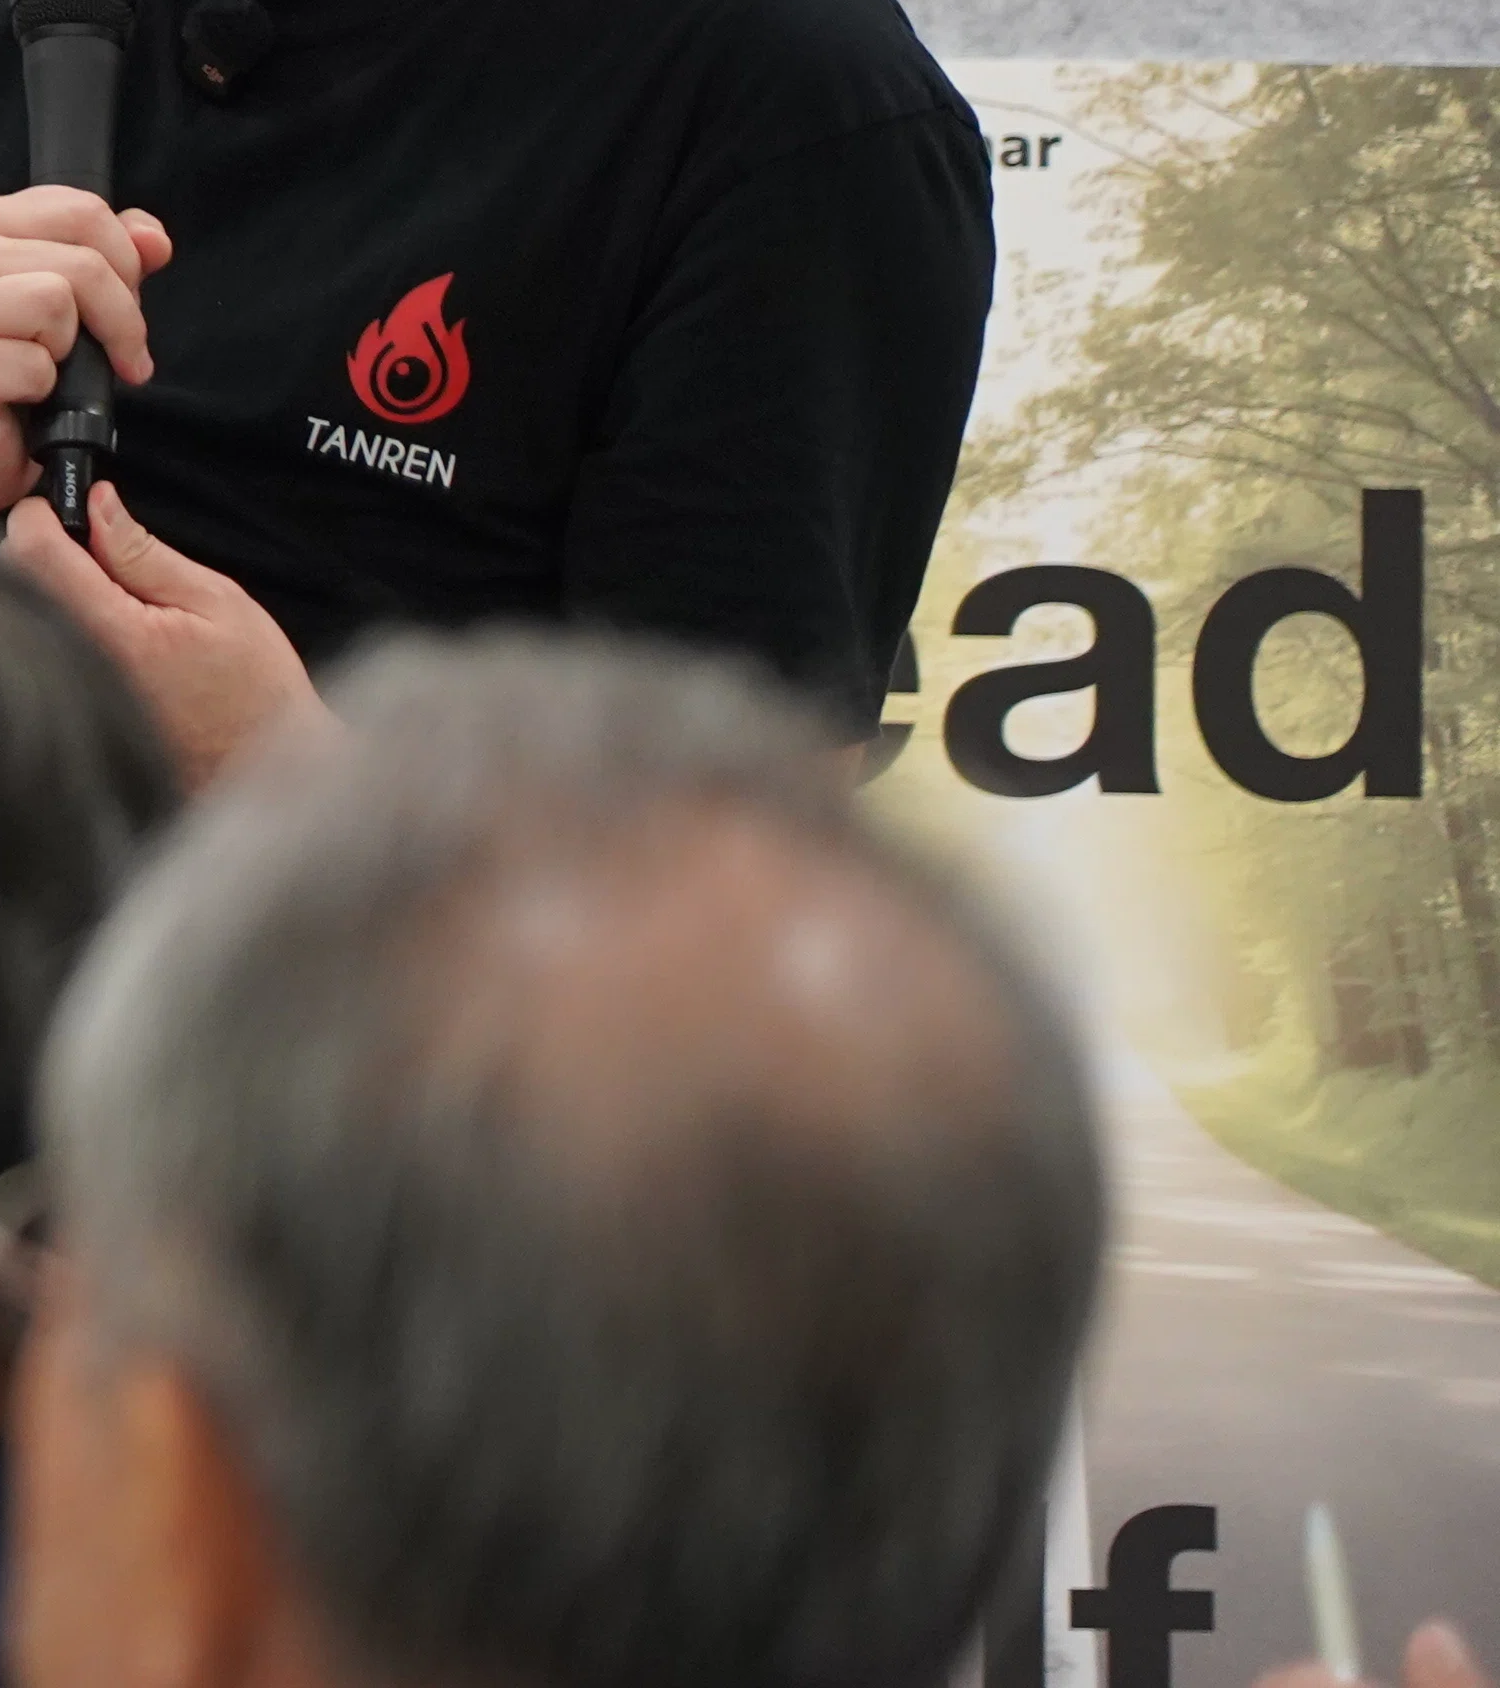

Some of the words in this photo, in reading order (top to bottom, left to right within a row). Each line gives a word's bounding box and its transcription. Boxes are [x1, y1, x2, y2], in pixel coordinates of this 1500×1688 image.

[982, 134, 1062, 168] ar
[306, 416, 456, 488] TANREN
[64, 459, 77, 508] SONY
[850, 488, 1424, 802] ad
